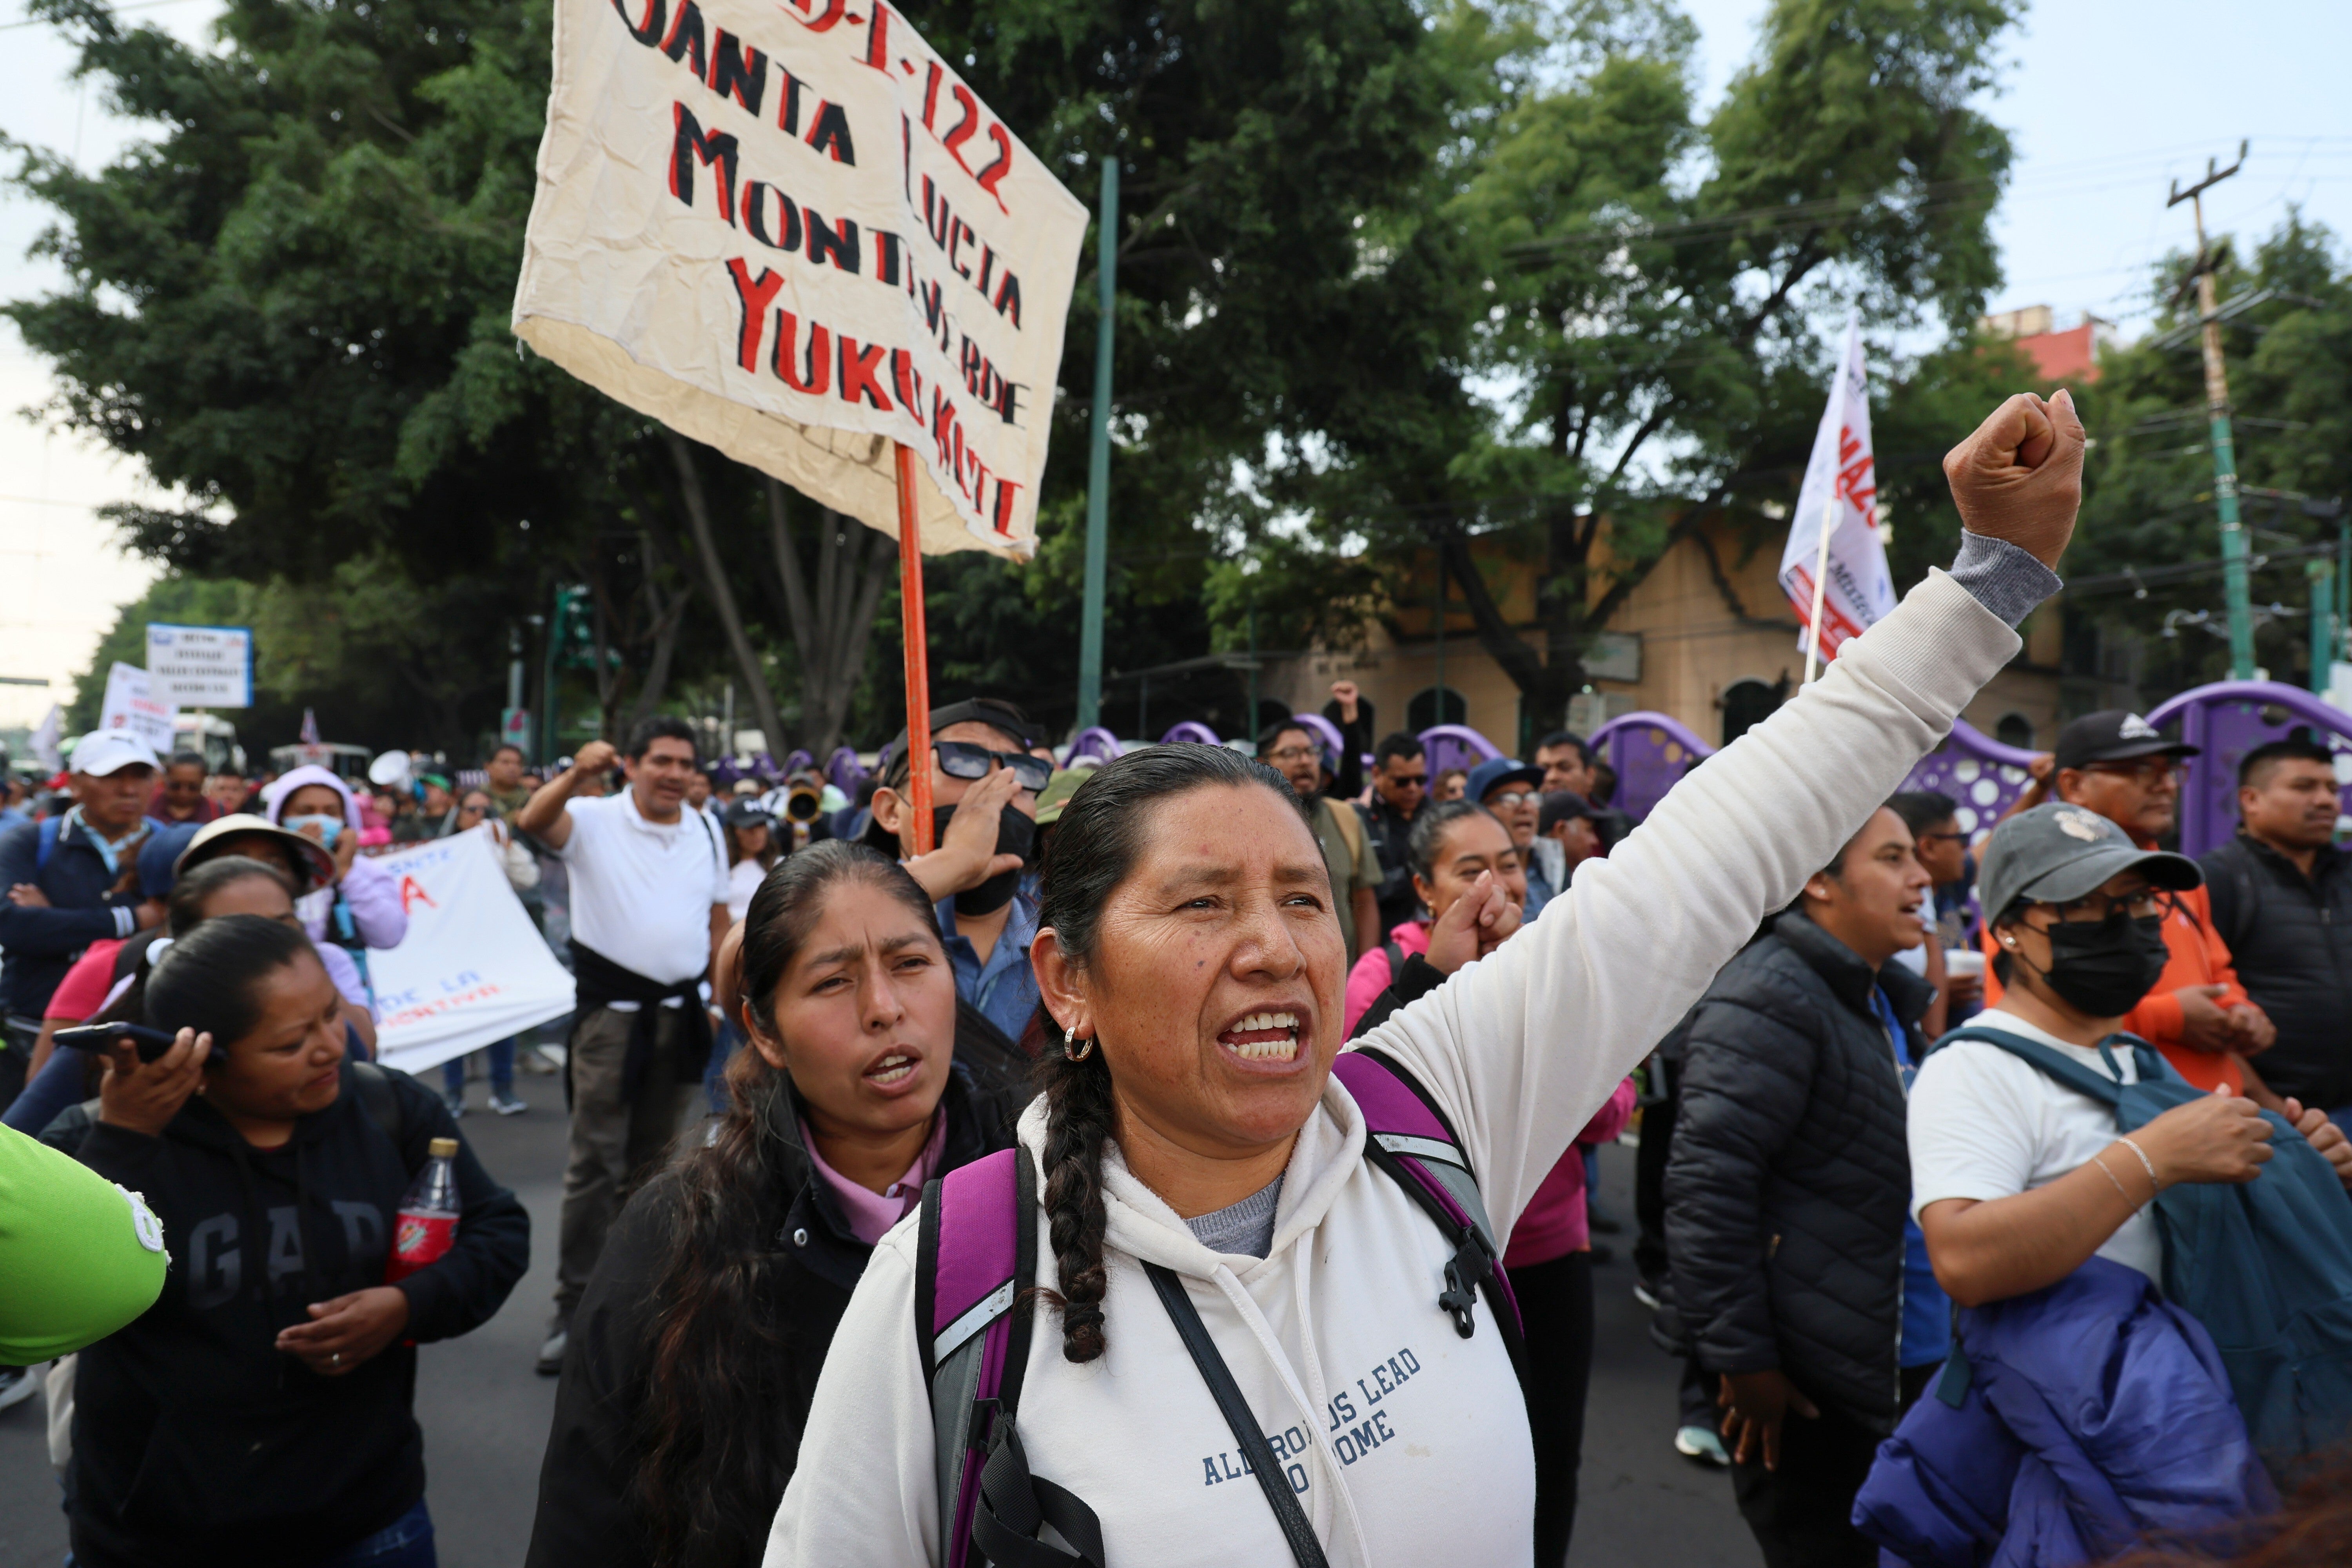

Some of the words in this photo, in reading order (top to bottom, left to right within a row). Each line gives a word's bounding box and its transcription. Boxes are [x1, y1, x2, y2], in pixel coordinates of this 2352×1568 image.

[187, 1199, 386, 1311] GAP
[1357, 1348, 1421, 1406] LEAD
[1331, 1410, 1395, 1470] OME
